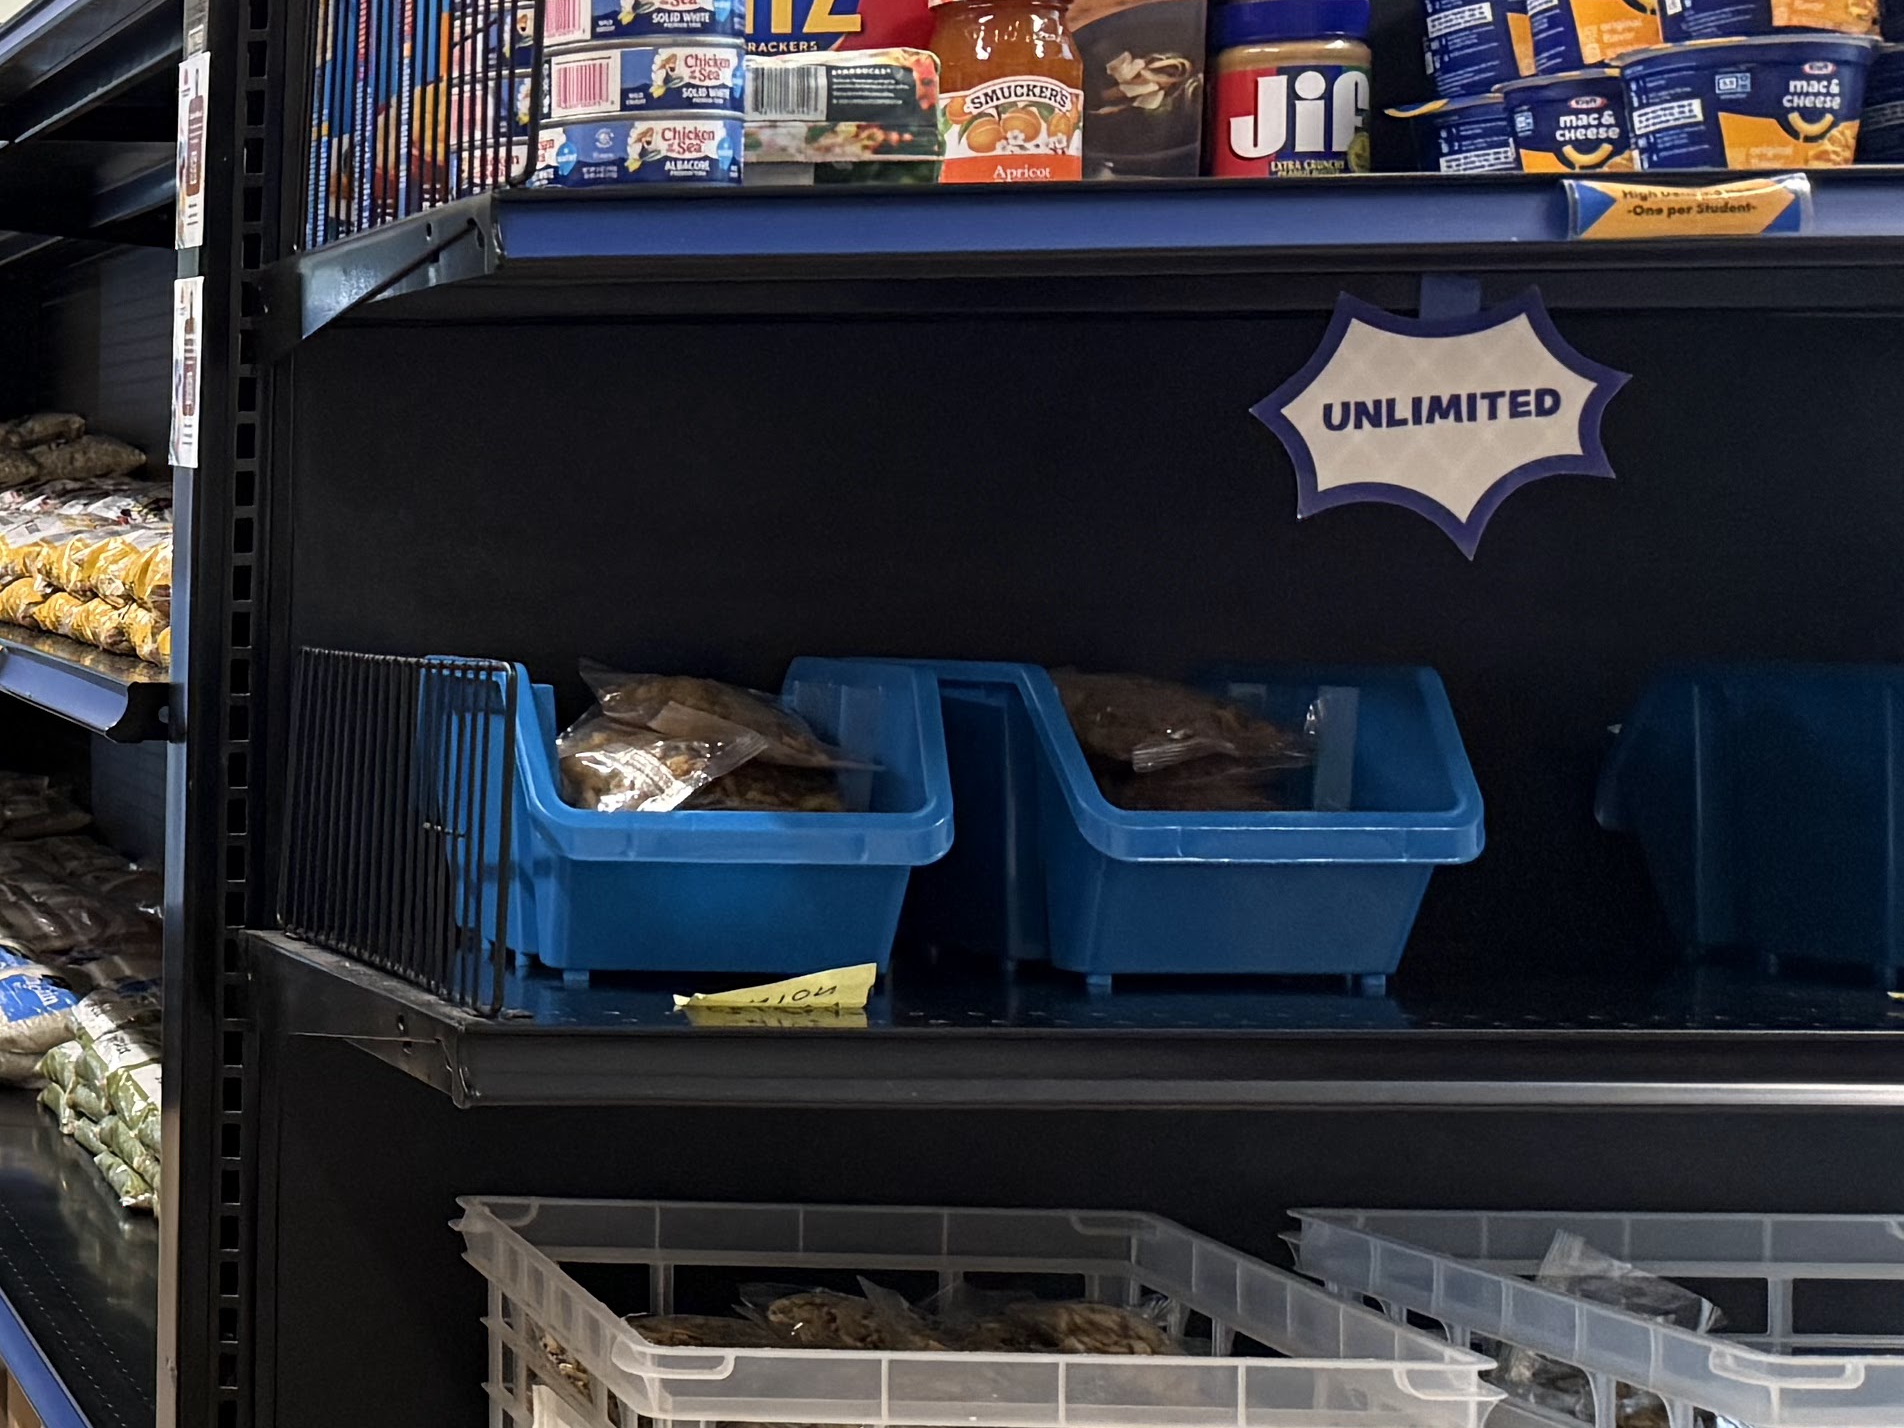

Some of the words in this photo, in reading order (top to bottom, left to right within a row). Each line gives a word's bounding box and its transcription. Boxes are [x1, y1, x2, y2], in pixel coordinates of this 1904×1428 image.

[652, 13, 680, 22] SOLID
[683, 13, 709, 22] WHITE
[745, 41, 818, 52] RACKERS
[684, 54, 730, 70] Chicken
[699, 68, 720, 81] Sea
[1789, 80, 1827, 93] mac
[970, 83, 1069, 111] SMUCKER'S
[1230, 71, 1370, 158] Jif
[1559, 113, 1598, 127] mac
[661, 127, 714, 142] Chicken
[678, 141, 703, 154] Sea
[993, 164, 1050, 182] Apricot
[1668, 204, 1692, 217] per
[1323, 388, 1561, 431] UNLIMITED
